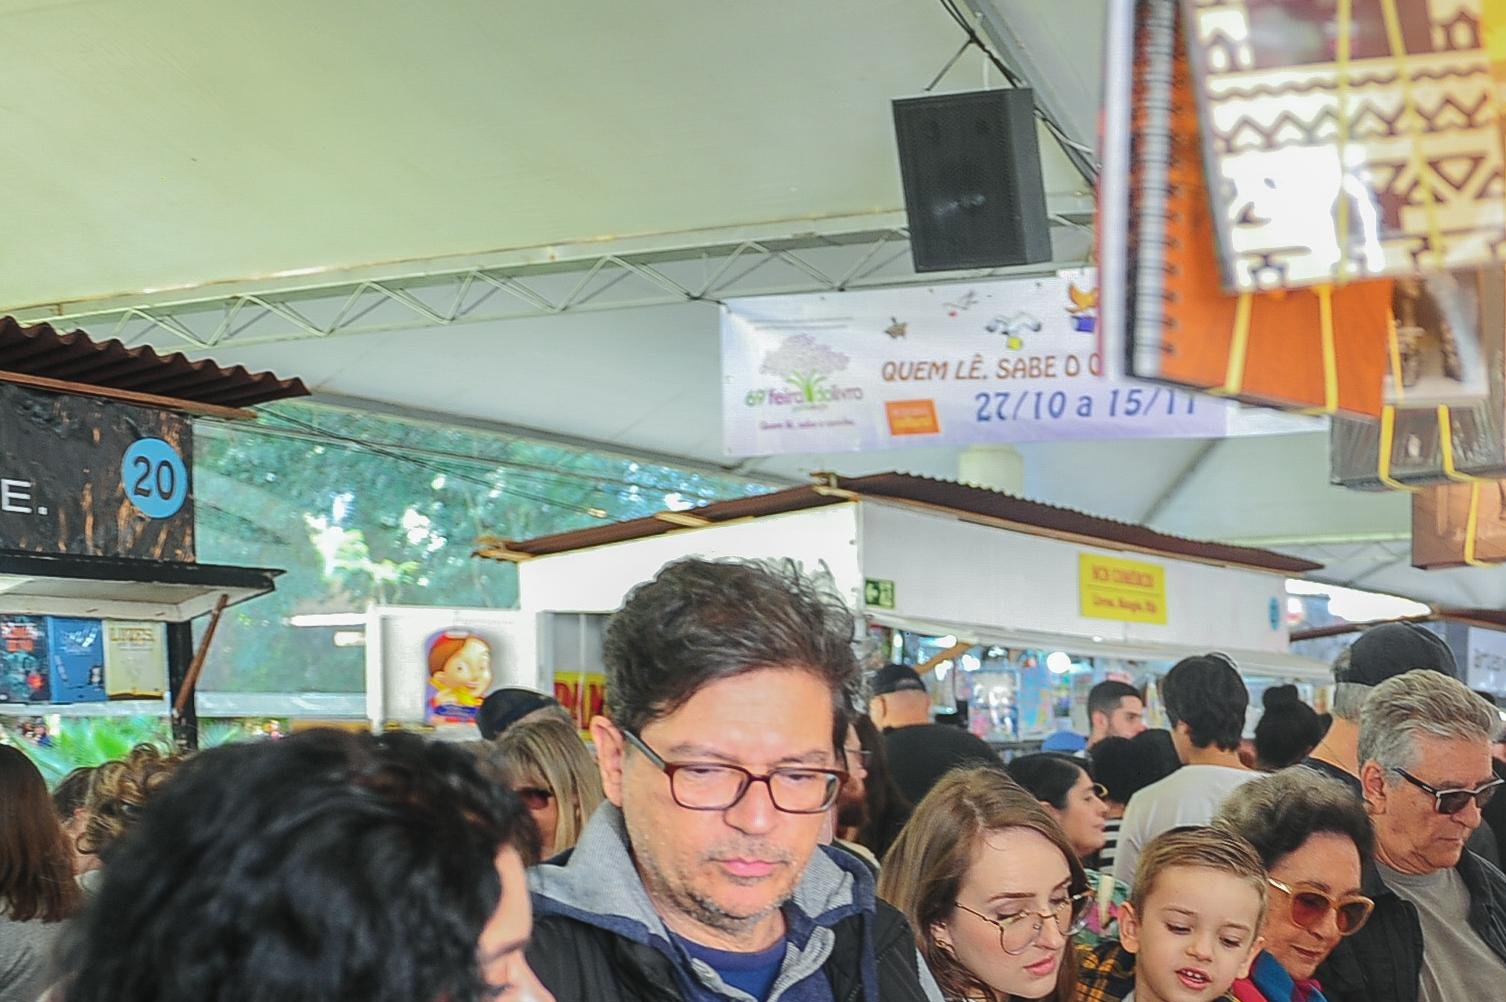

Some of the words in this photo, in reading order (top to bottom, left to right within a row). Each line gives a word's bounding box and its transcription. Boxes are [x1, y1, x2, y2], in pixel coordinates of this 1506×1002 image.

[882, 359, 949, 382] QUEM
[996, 355, 1057, 379] SABE
[975, 390, 1066, 422] 27/10
[1076, 395, 1093, 417] a
[133, 455, 175, 501] 20
